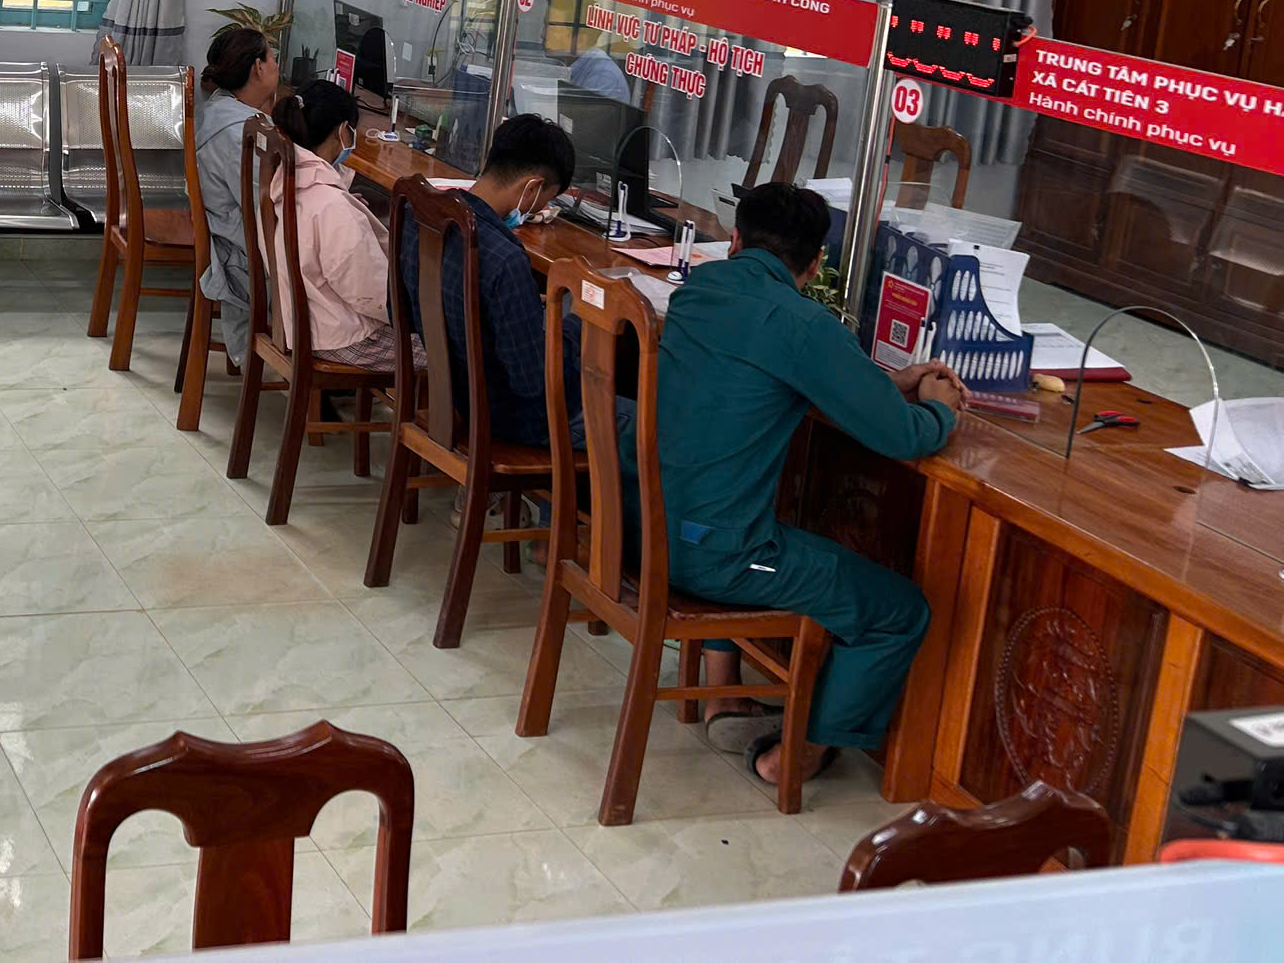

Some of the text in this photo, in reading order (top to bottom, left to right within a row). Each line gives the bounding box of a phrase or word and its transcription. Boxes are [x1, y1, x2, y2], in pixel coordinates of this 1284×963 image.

[680, 6, 695, 17] vụ
[586, 3, 615, 33] LĨNH
[616, 13, 641, 42] VỰC
[643, 20, 662, 45] TƯ
[660, 26, 698, 56] PHÁP
[707, 37, 729, 71] HỘ
[731, 45, 766, 77] TỊCH
[625, 51, 706, 100] CHỨNG THỰC
[1032, 70, 1170, 114] XÃ CÁT TIÊN 3
[1036, 49, 1103, 76] TRUNG
[1107, 65, 1149, 86] TÂM
[1153, 75, 1219, 101] PHỤC
[1223, 90, 1258, 112] VỤ
[894, 85, 921, 116] 03
[1029, 91, 1237, 156] Hành chính phục vụ
